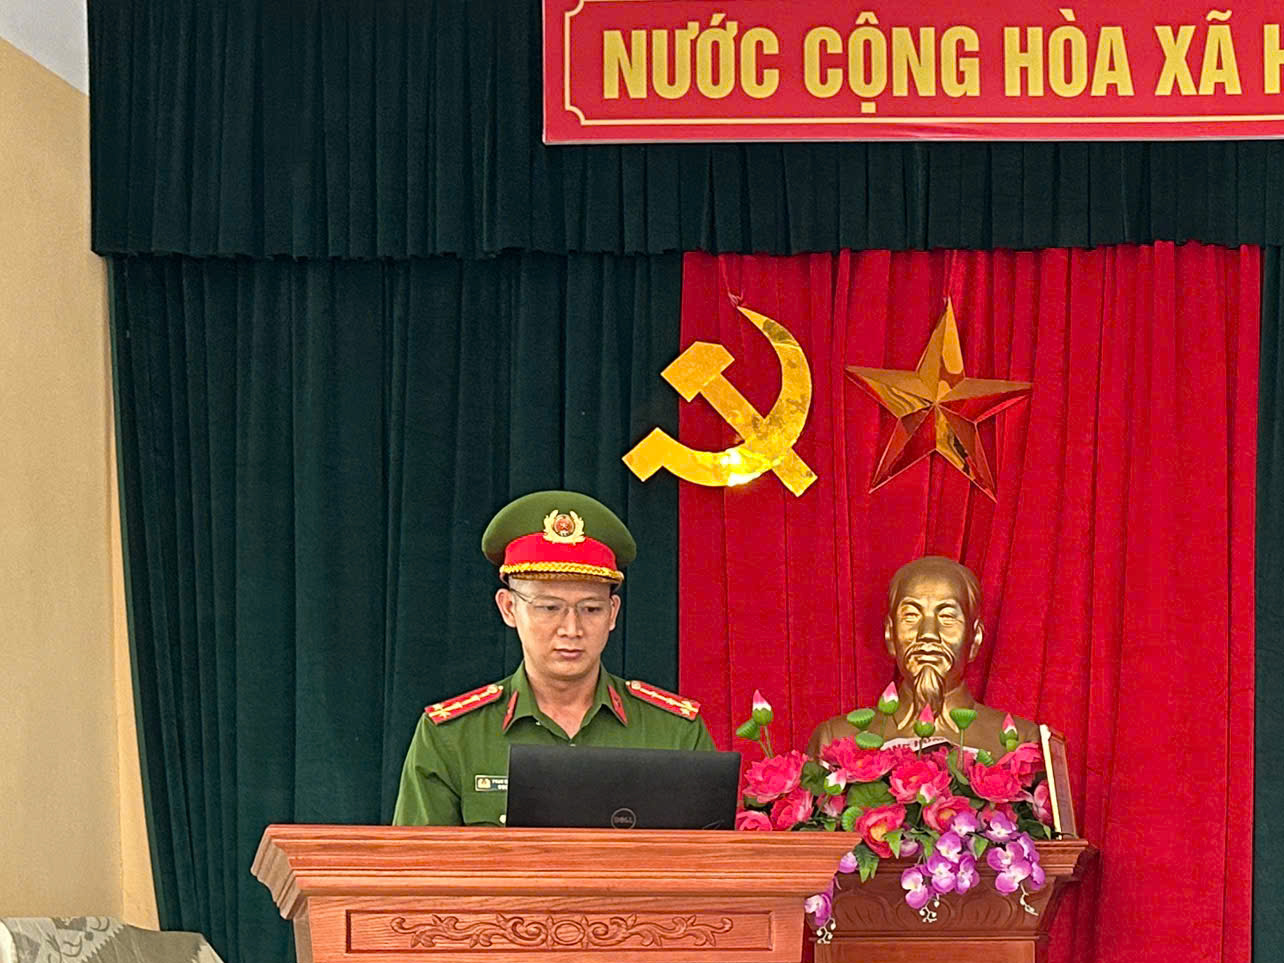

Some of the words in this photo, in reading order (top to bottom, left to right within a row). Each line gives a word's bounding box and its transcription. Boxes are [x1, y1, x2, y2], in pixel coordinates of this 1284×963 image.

[605, 13, 780, 100] NƯỚC
[805, 11, 981, 114] CỘNG
[1006, 10, 1134, 98] HÒA
[1157, 11, 1242, 96] XÃ
